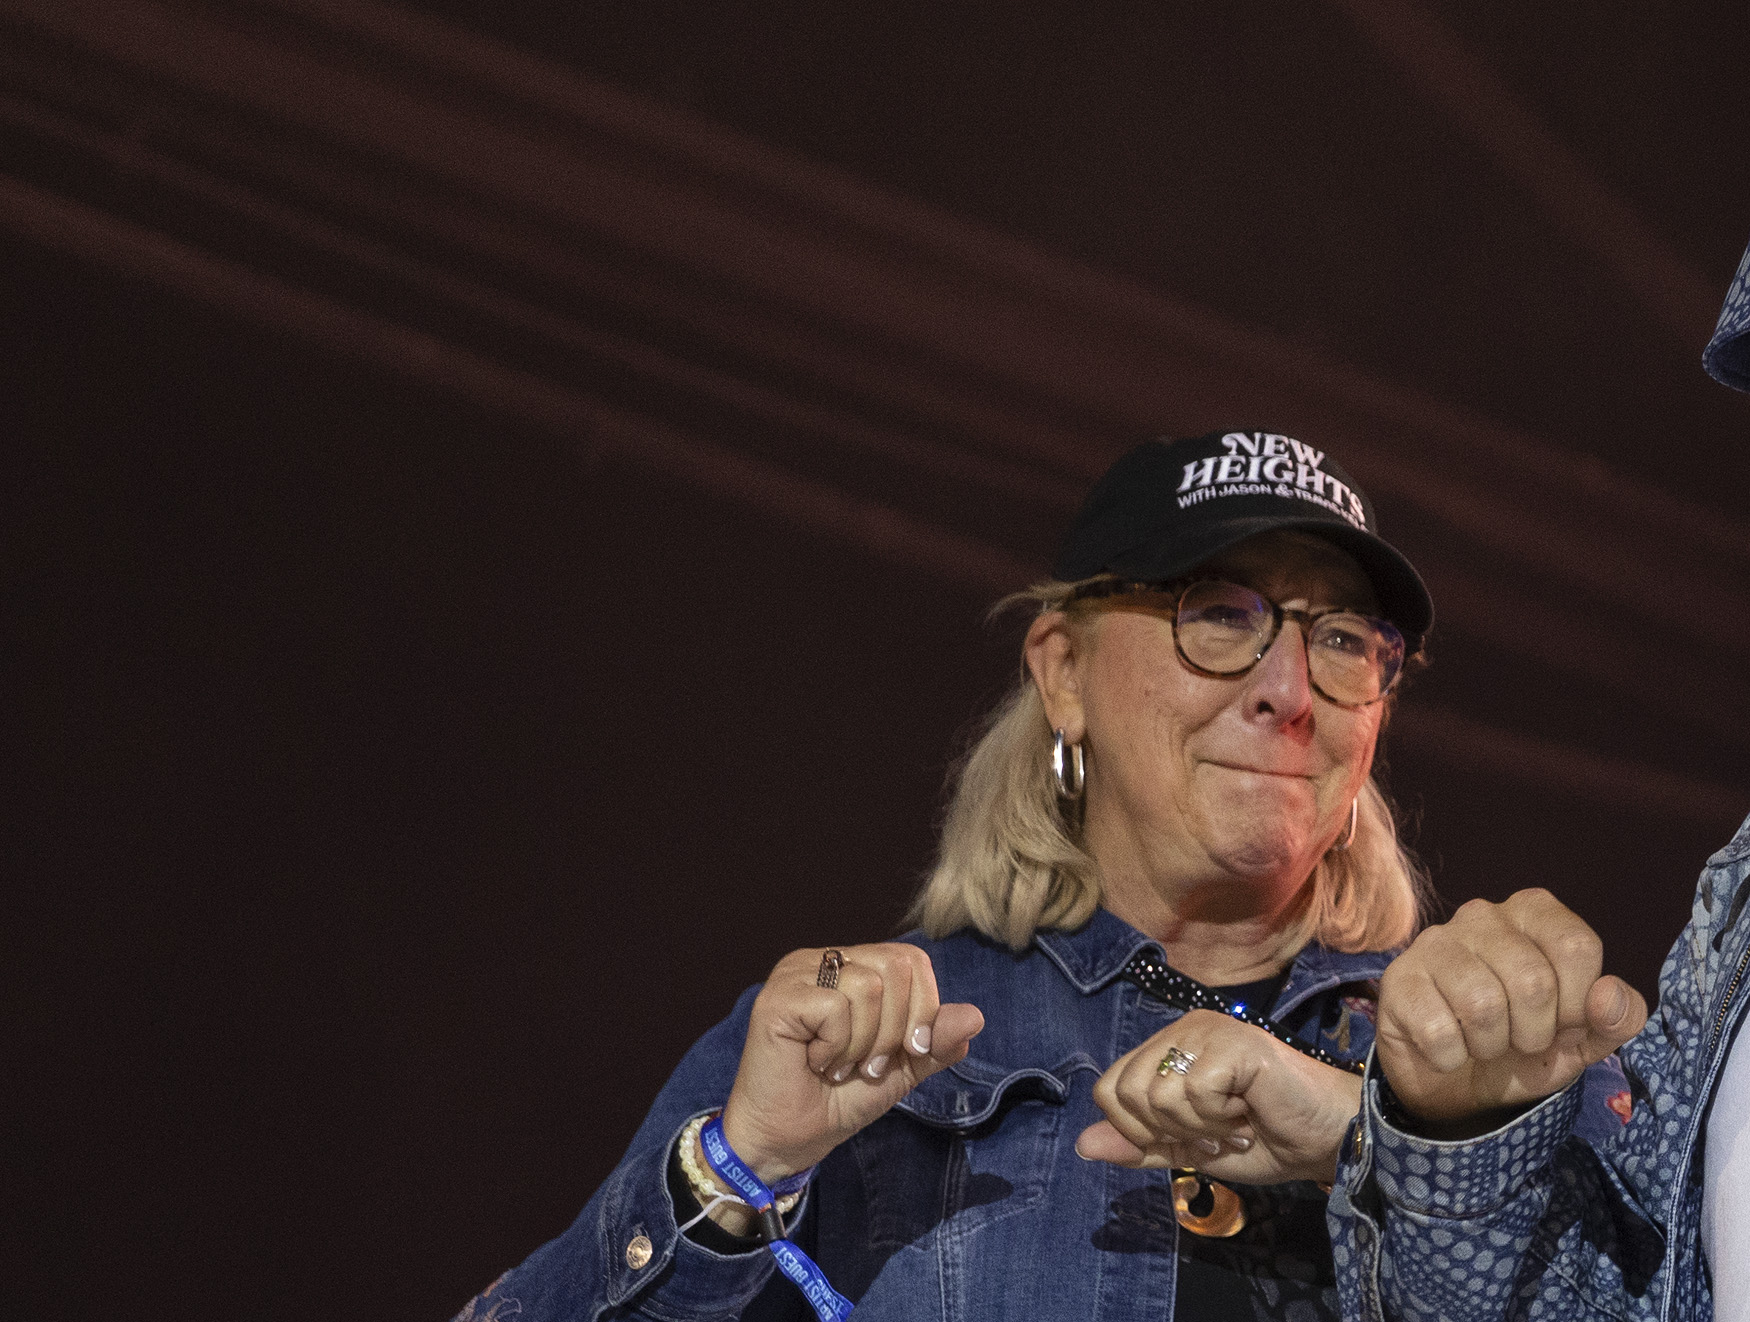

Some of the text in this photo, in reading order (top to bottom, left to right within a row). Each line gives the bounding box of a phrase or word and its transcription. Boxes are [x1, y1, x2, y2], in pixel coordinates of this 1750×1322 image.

[1221, 431, 1325, 468] NEW
[1176, 455, 1366, 525] HEIGHTS
[1177, 485, 1217, 510] WITH
[1219, 483, 1273, 498] JASON
[1273, 483, 1295, 499] &
[704, 1127, 762, 1198] ARTIST GUEST
[773, 1247, 834, 1321] ARTIST GUEST
